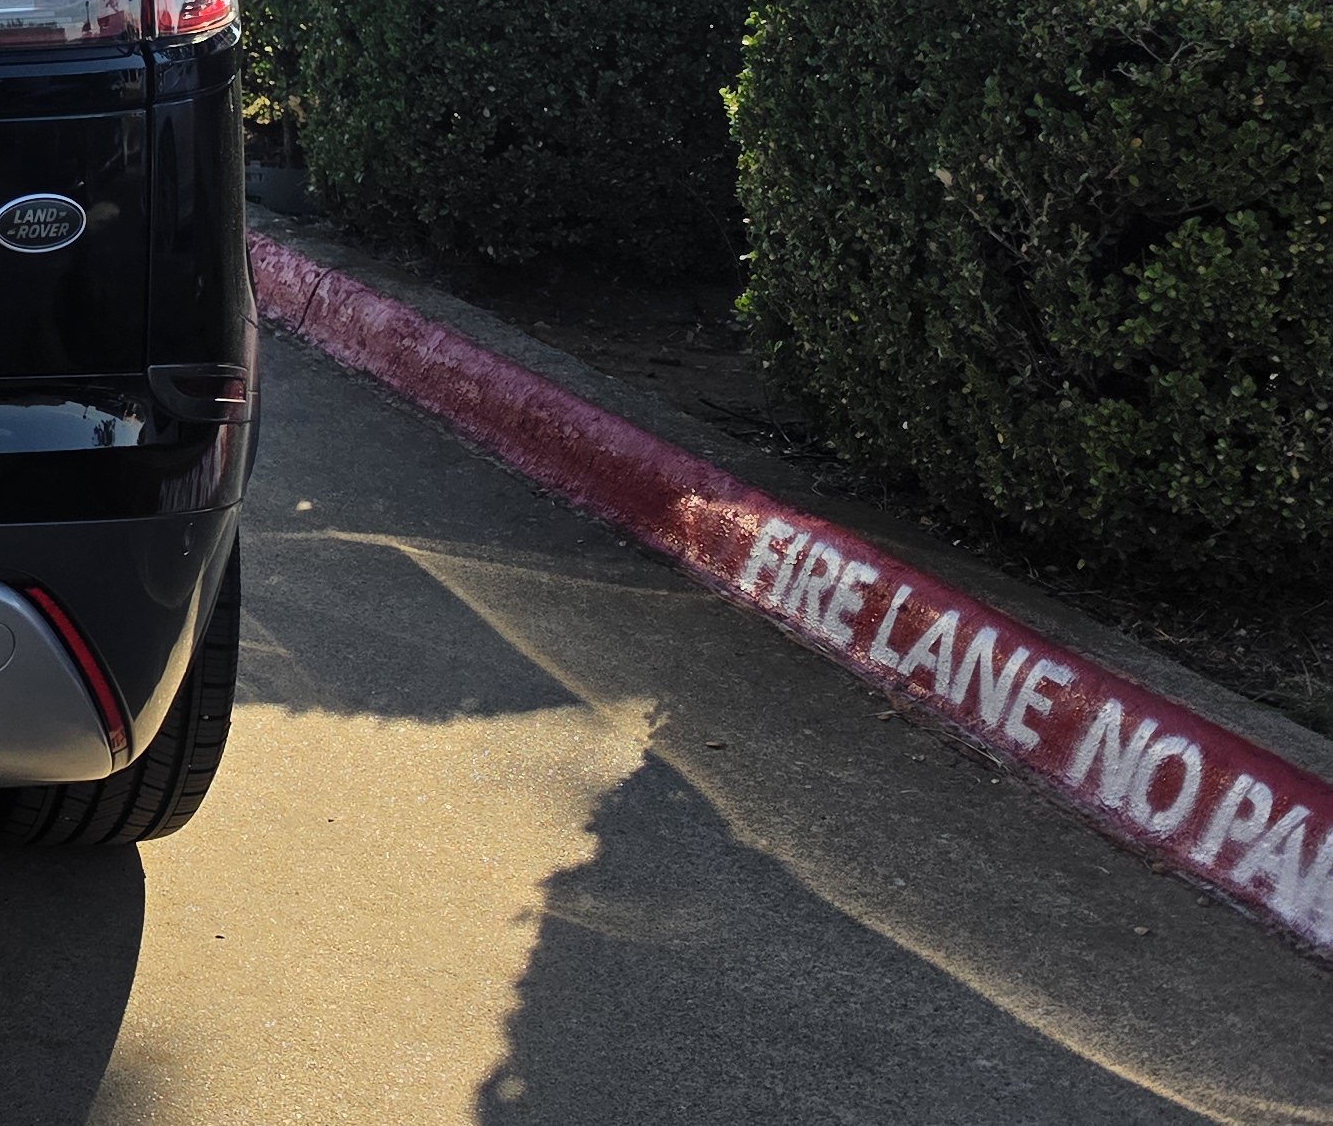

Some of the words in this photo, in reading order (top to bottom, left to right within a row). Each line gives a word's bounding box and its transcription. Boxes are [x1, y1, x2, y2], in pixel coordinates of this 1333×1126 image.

[739, 517, 882, 649] FIRE
[870, 583, 1077, 751] LANE
[1064, 696, 1204, 840] NO
